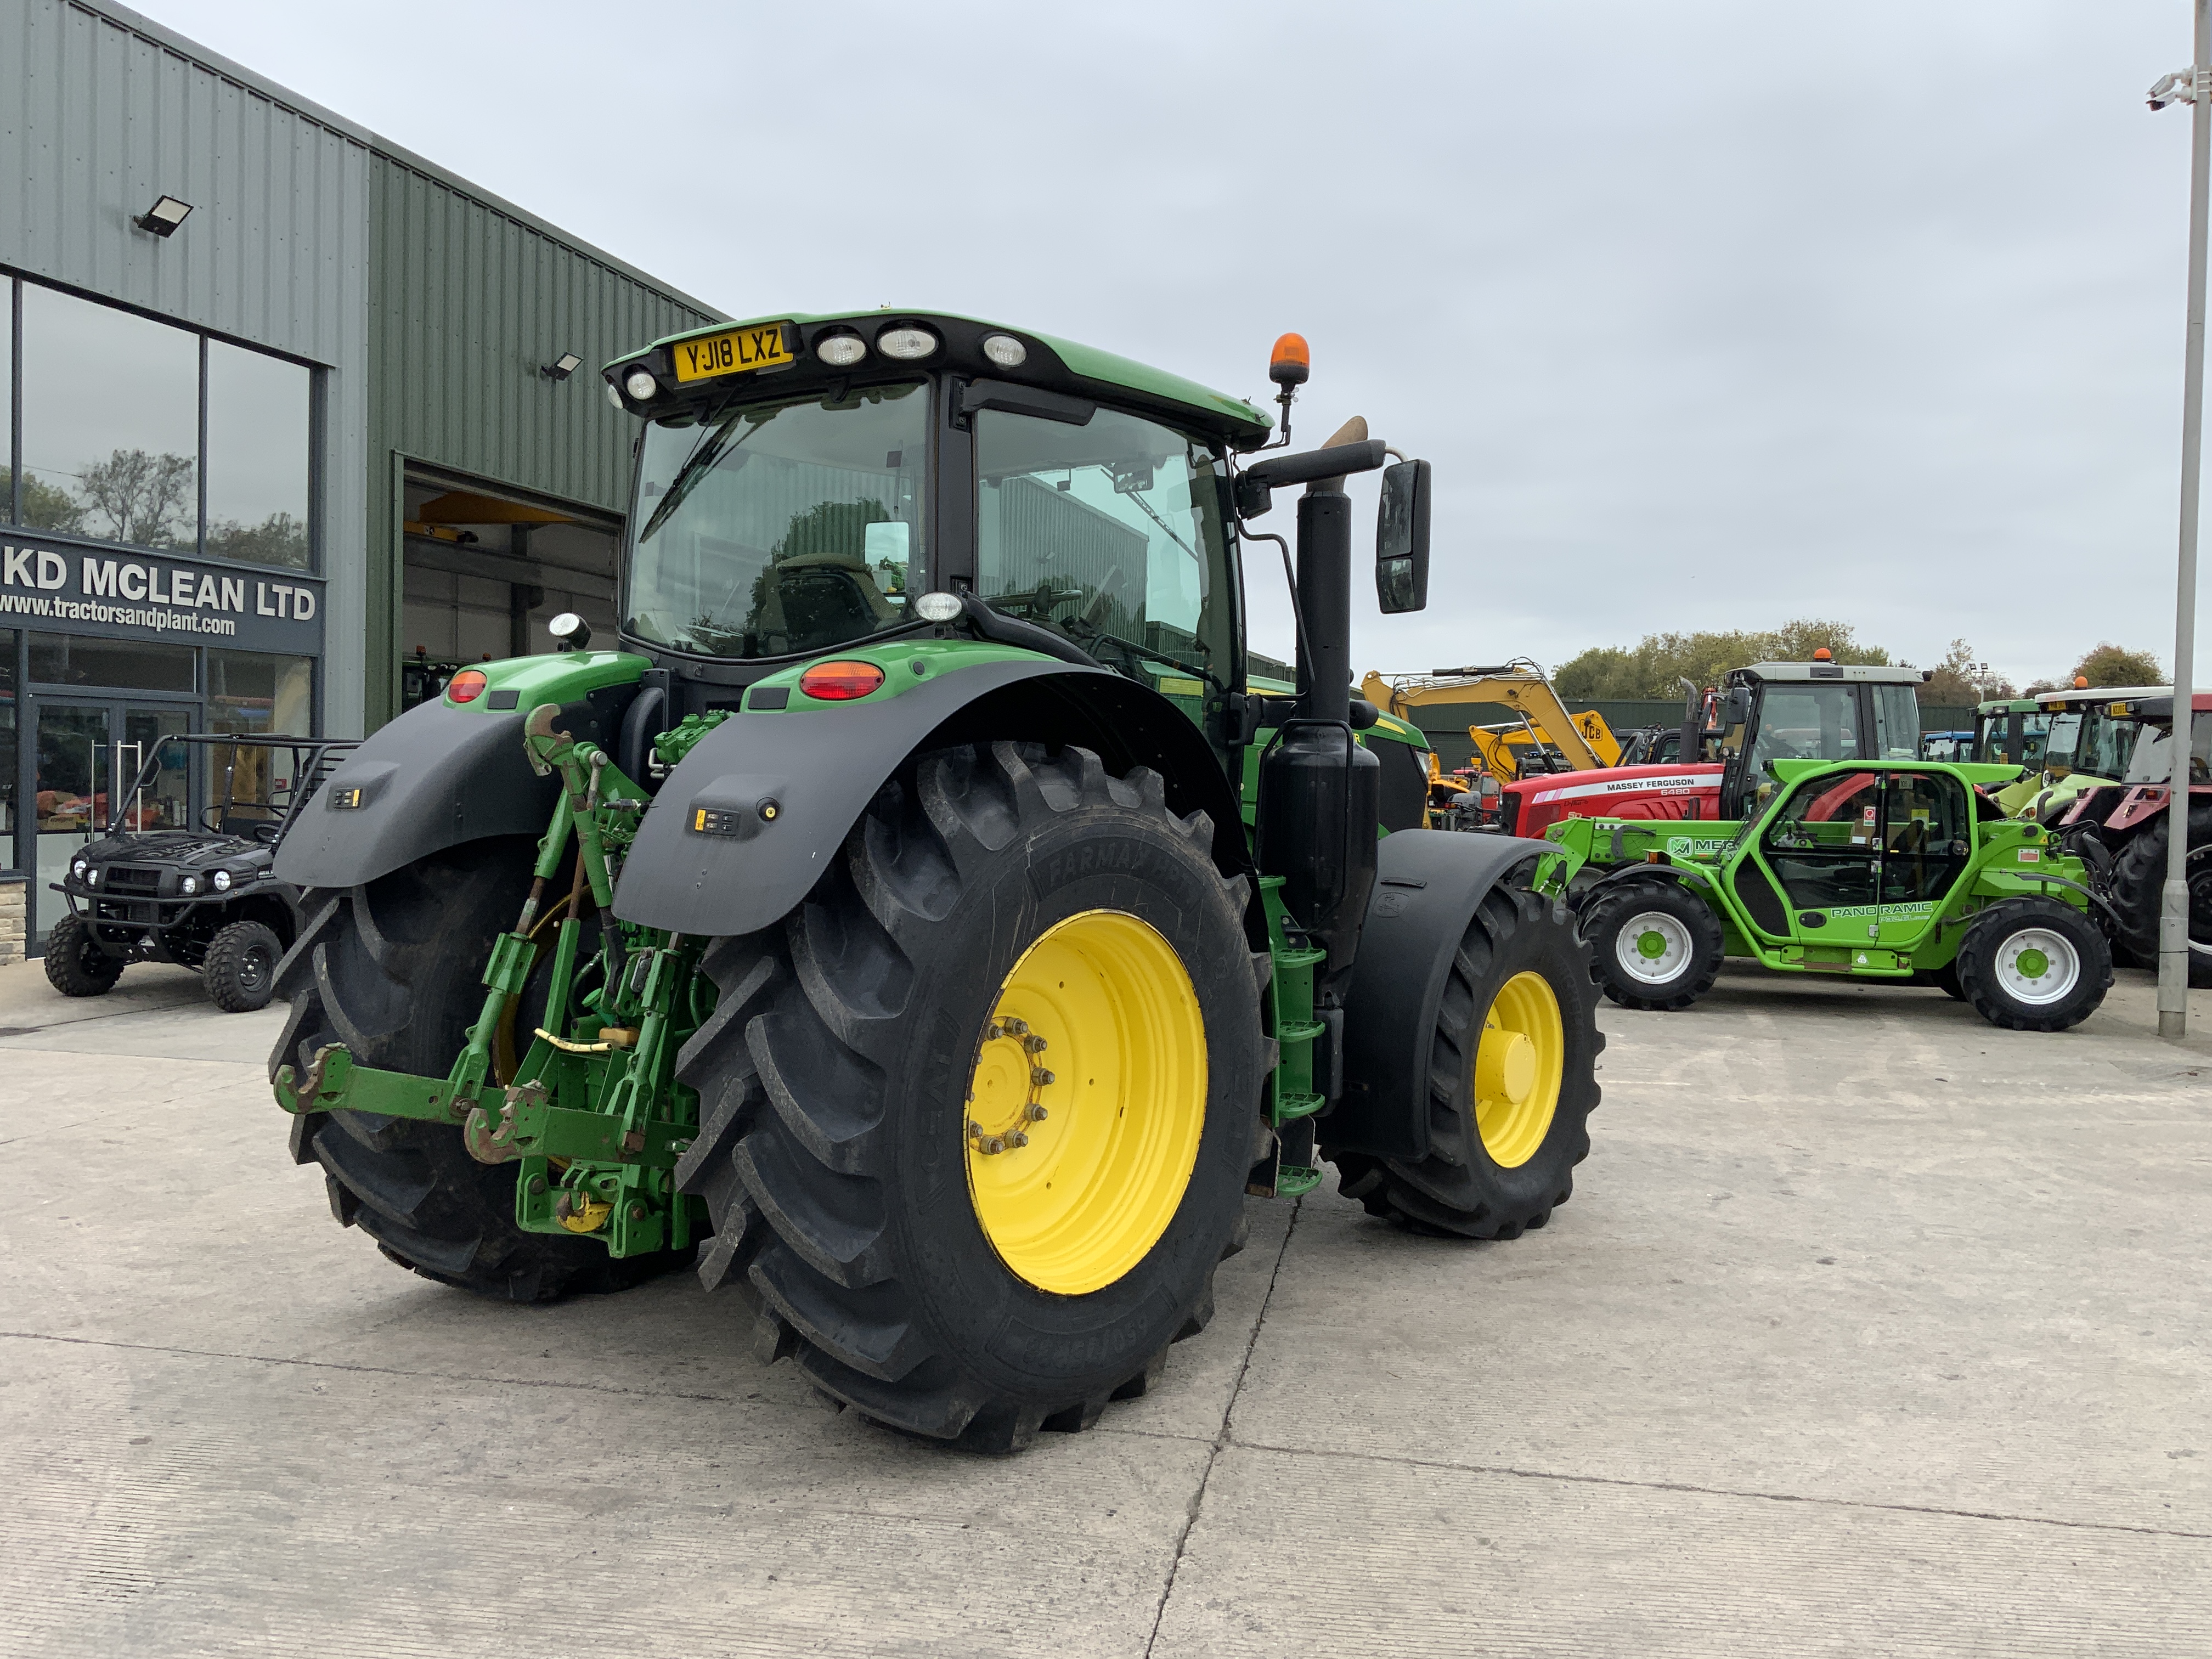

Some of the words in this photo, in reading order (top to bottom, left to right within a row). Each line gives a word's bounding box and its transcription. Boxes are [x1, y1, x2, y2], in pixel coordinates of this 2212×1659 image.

[686, 338, 733, 373] YJ18
[738, 329, 781, 364] LXZ
[4, 545, 67, 590] KD
[83, 557, 244, 613] MCLEAN
[257, 582, 315, 620] LTD
[0, 594, 235, 636] www.tractorsandplant.com
[1582, 724, 1601, 739] JCB
[1607, 782, 1644, 791] MASSEY
[1646, 778, 1694, 788] FERGUSON
[1695, 840, 1737, 850] MER
[1831, 901, 1933, 918] PANORAMIC
